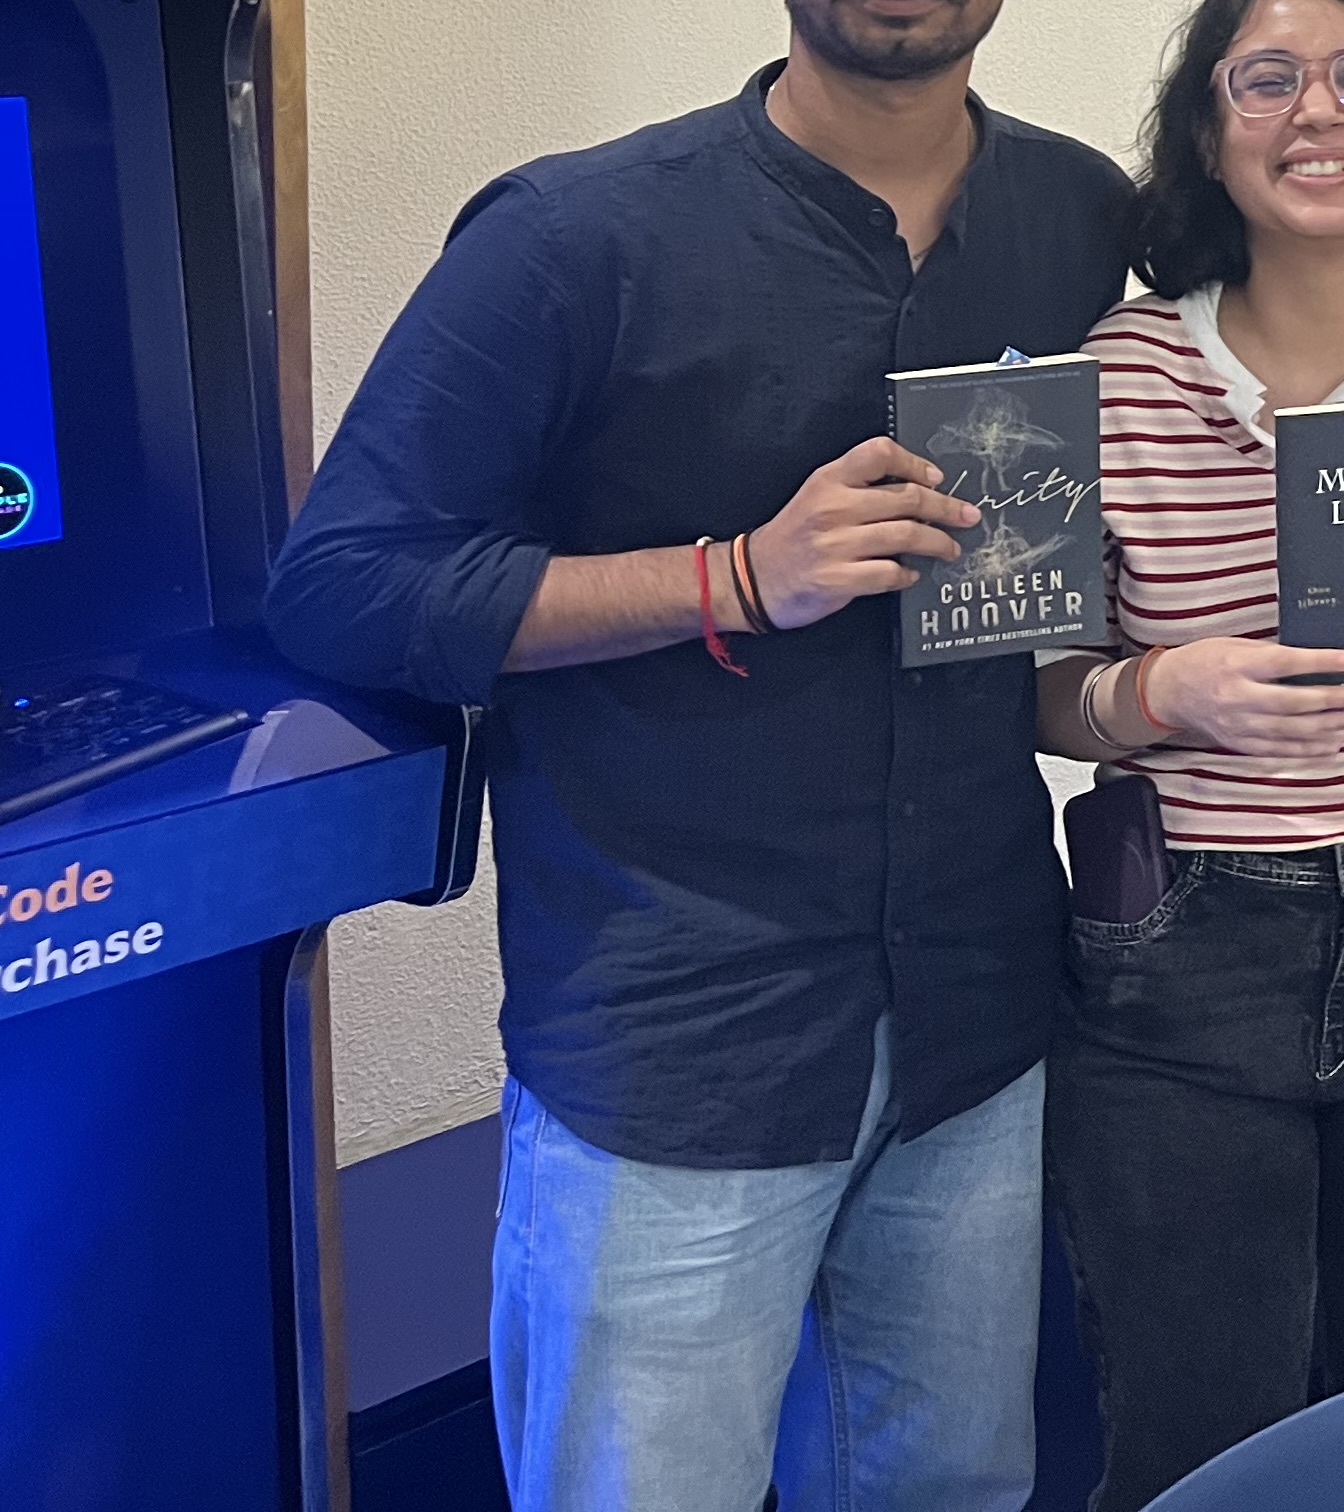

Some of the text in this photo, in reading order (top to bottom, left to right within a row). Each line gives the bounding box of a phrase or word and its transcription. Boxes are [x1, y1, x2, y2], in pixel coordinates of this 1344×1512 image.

[948, 467, 1101, 524] rity
[921, 591, 1084, 637] HOOVER
[940, 569, 1063, 605] COLLEEN
[0, 861, 114, 926] ode
[0, 921, 164, 994] chase
